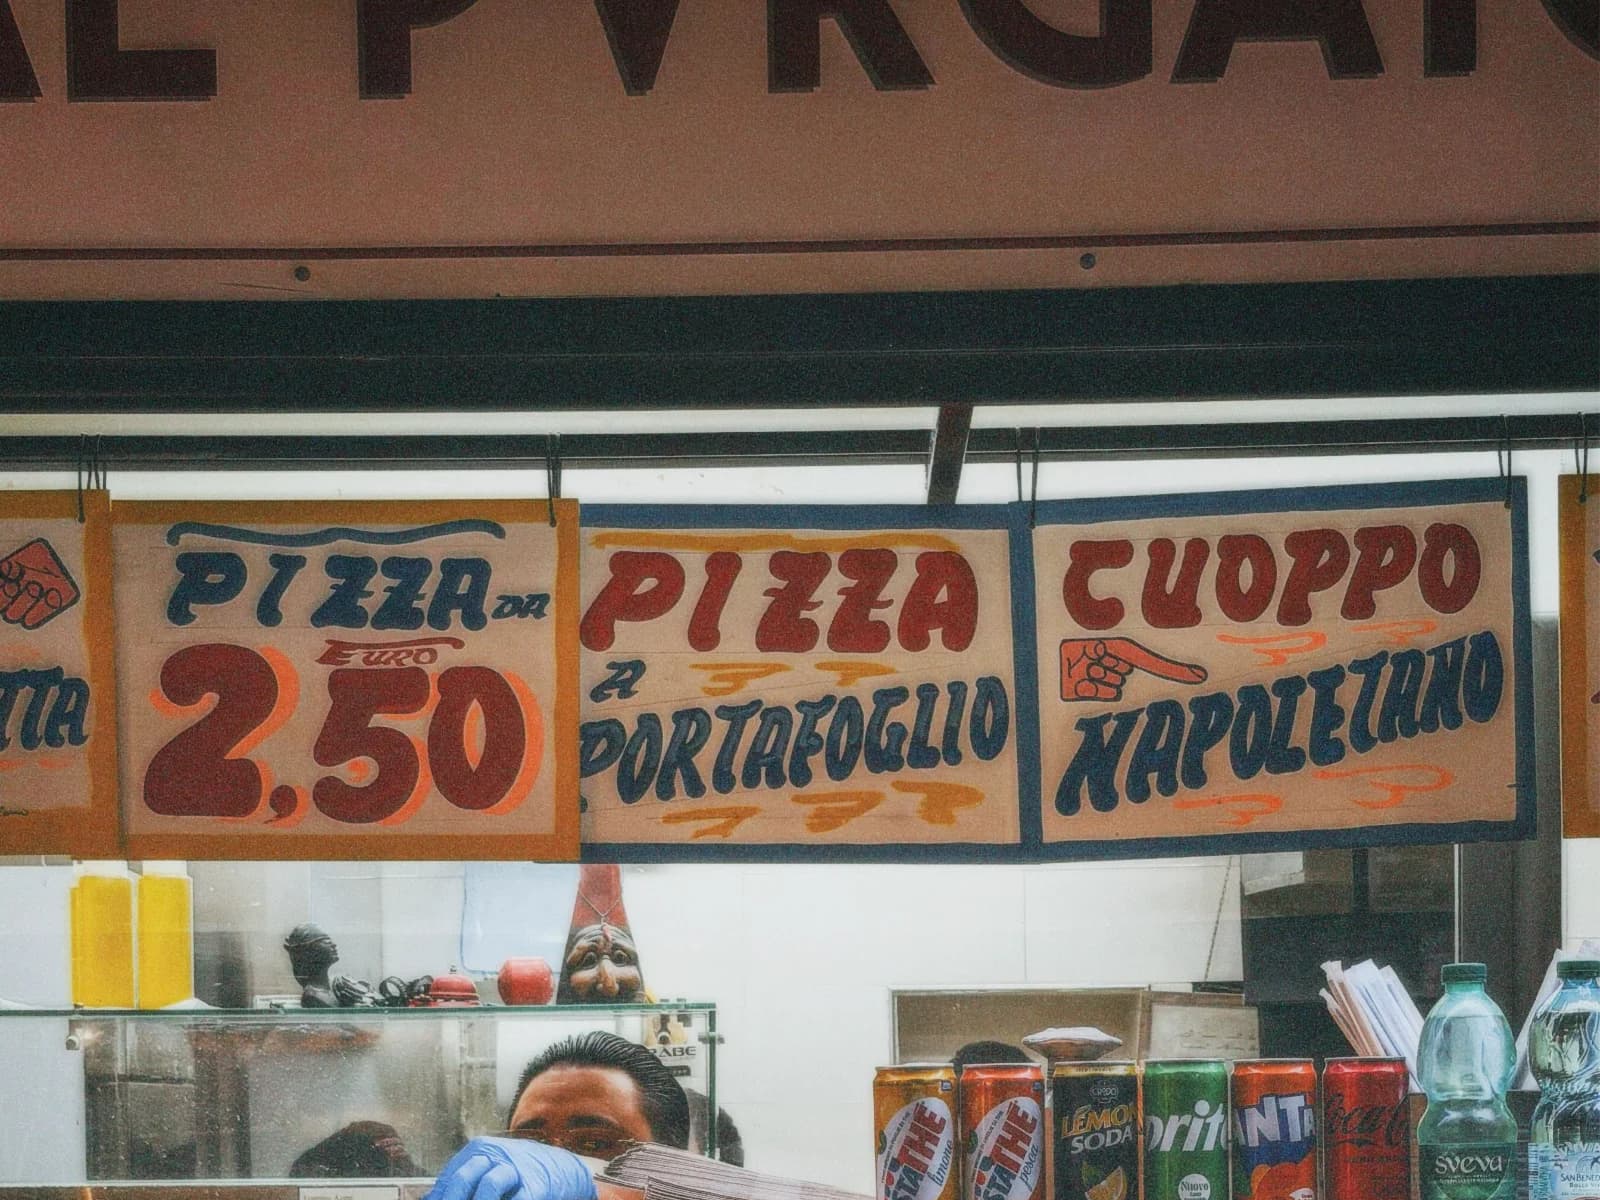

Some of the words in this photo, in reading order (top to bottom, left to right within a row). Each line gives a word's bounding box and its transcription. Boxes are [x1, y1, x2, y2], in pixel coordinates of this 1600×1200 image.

[166, 552, 492, 631] PIZZA
[579, 548, 979, 652] PIZZA
[1062, 522, 1482, 631] CUOPPO
[314, 638, 465, 667] EURO
[590, 659, 646, 703] A
[144, 643, 528, 826] 2,50
[580, 676, 1010, 805] PORTAFOGLIO
[1054, 630, 1504, 817] NAPOLETANO
[1071, 1124, 1132, 1155] SODA
